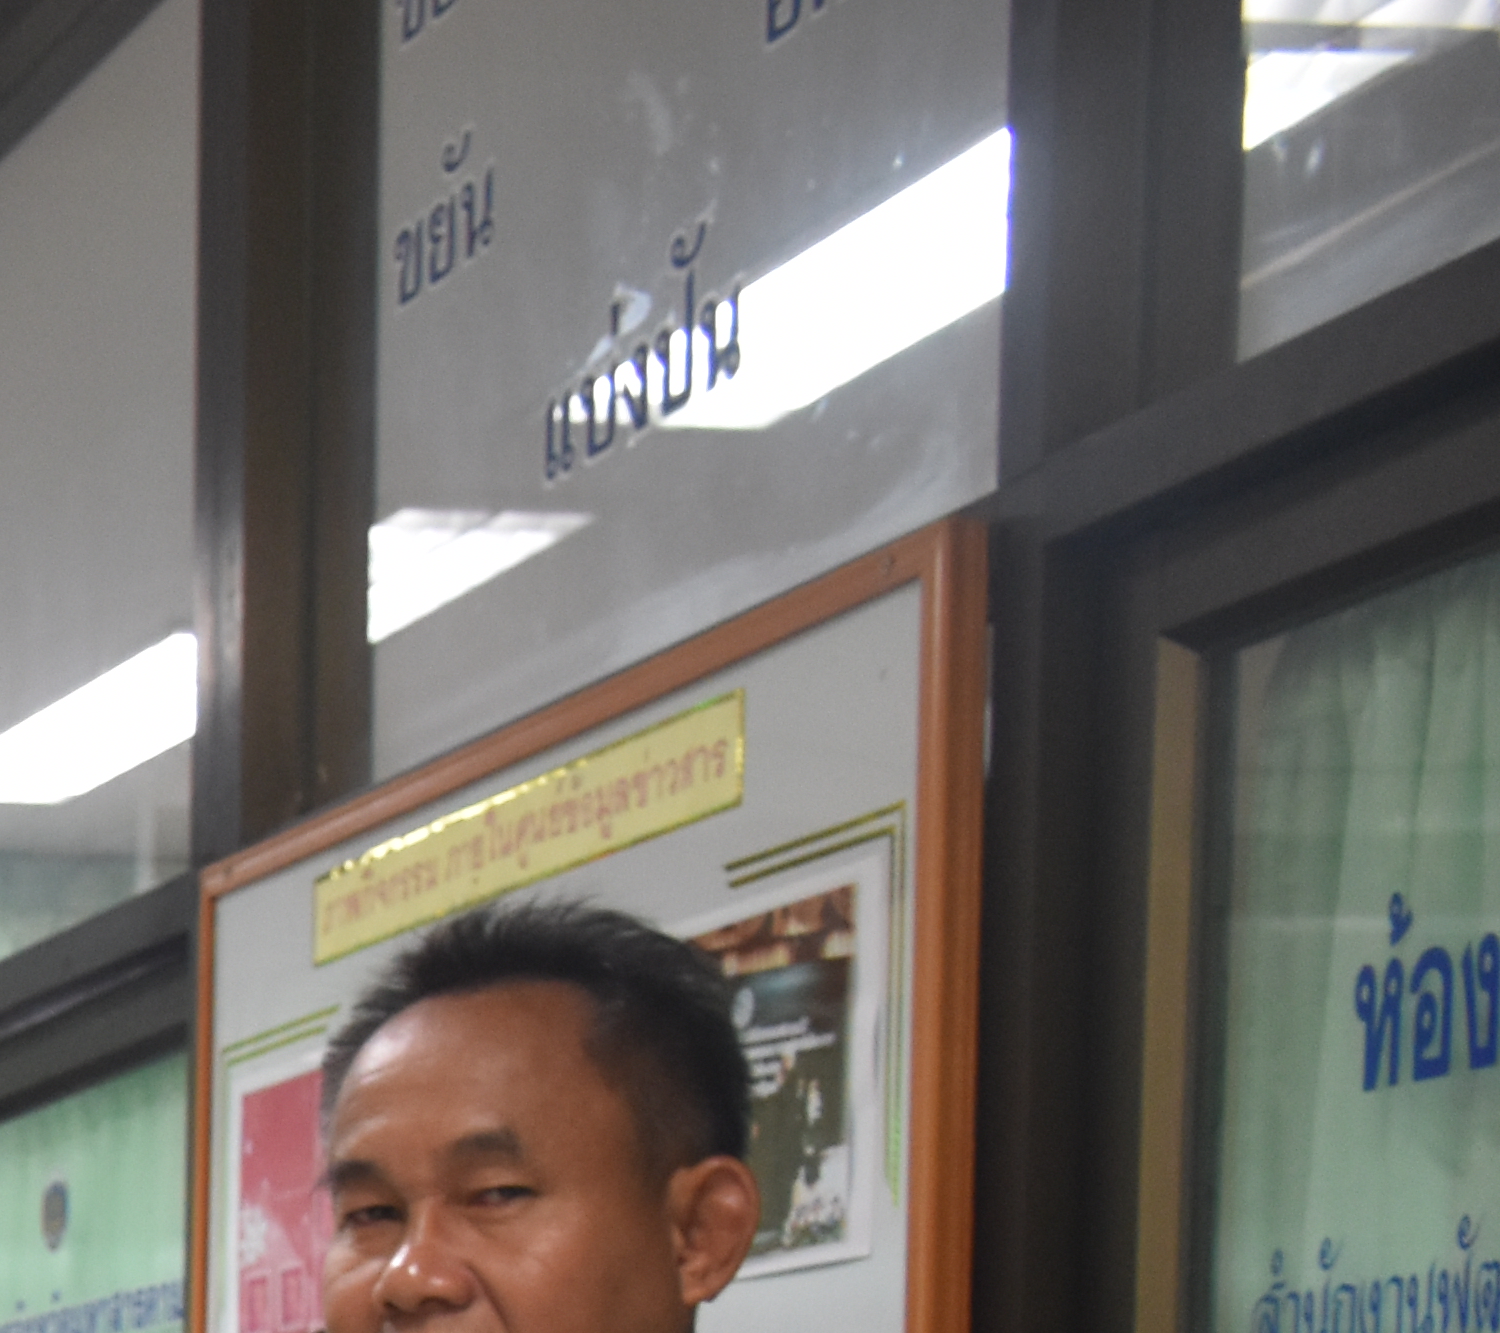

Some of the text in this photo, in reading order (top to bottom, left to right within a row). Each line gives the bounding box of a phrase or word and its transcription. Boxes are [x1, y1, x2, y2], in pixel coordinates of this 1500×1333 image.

[395, 129, 495, 305] ขยัน
[545, 220, 741, 480] แบ่งปัน
[1354, 891, 1500, 1093] ห้อง
